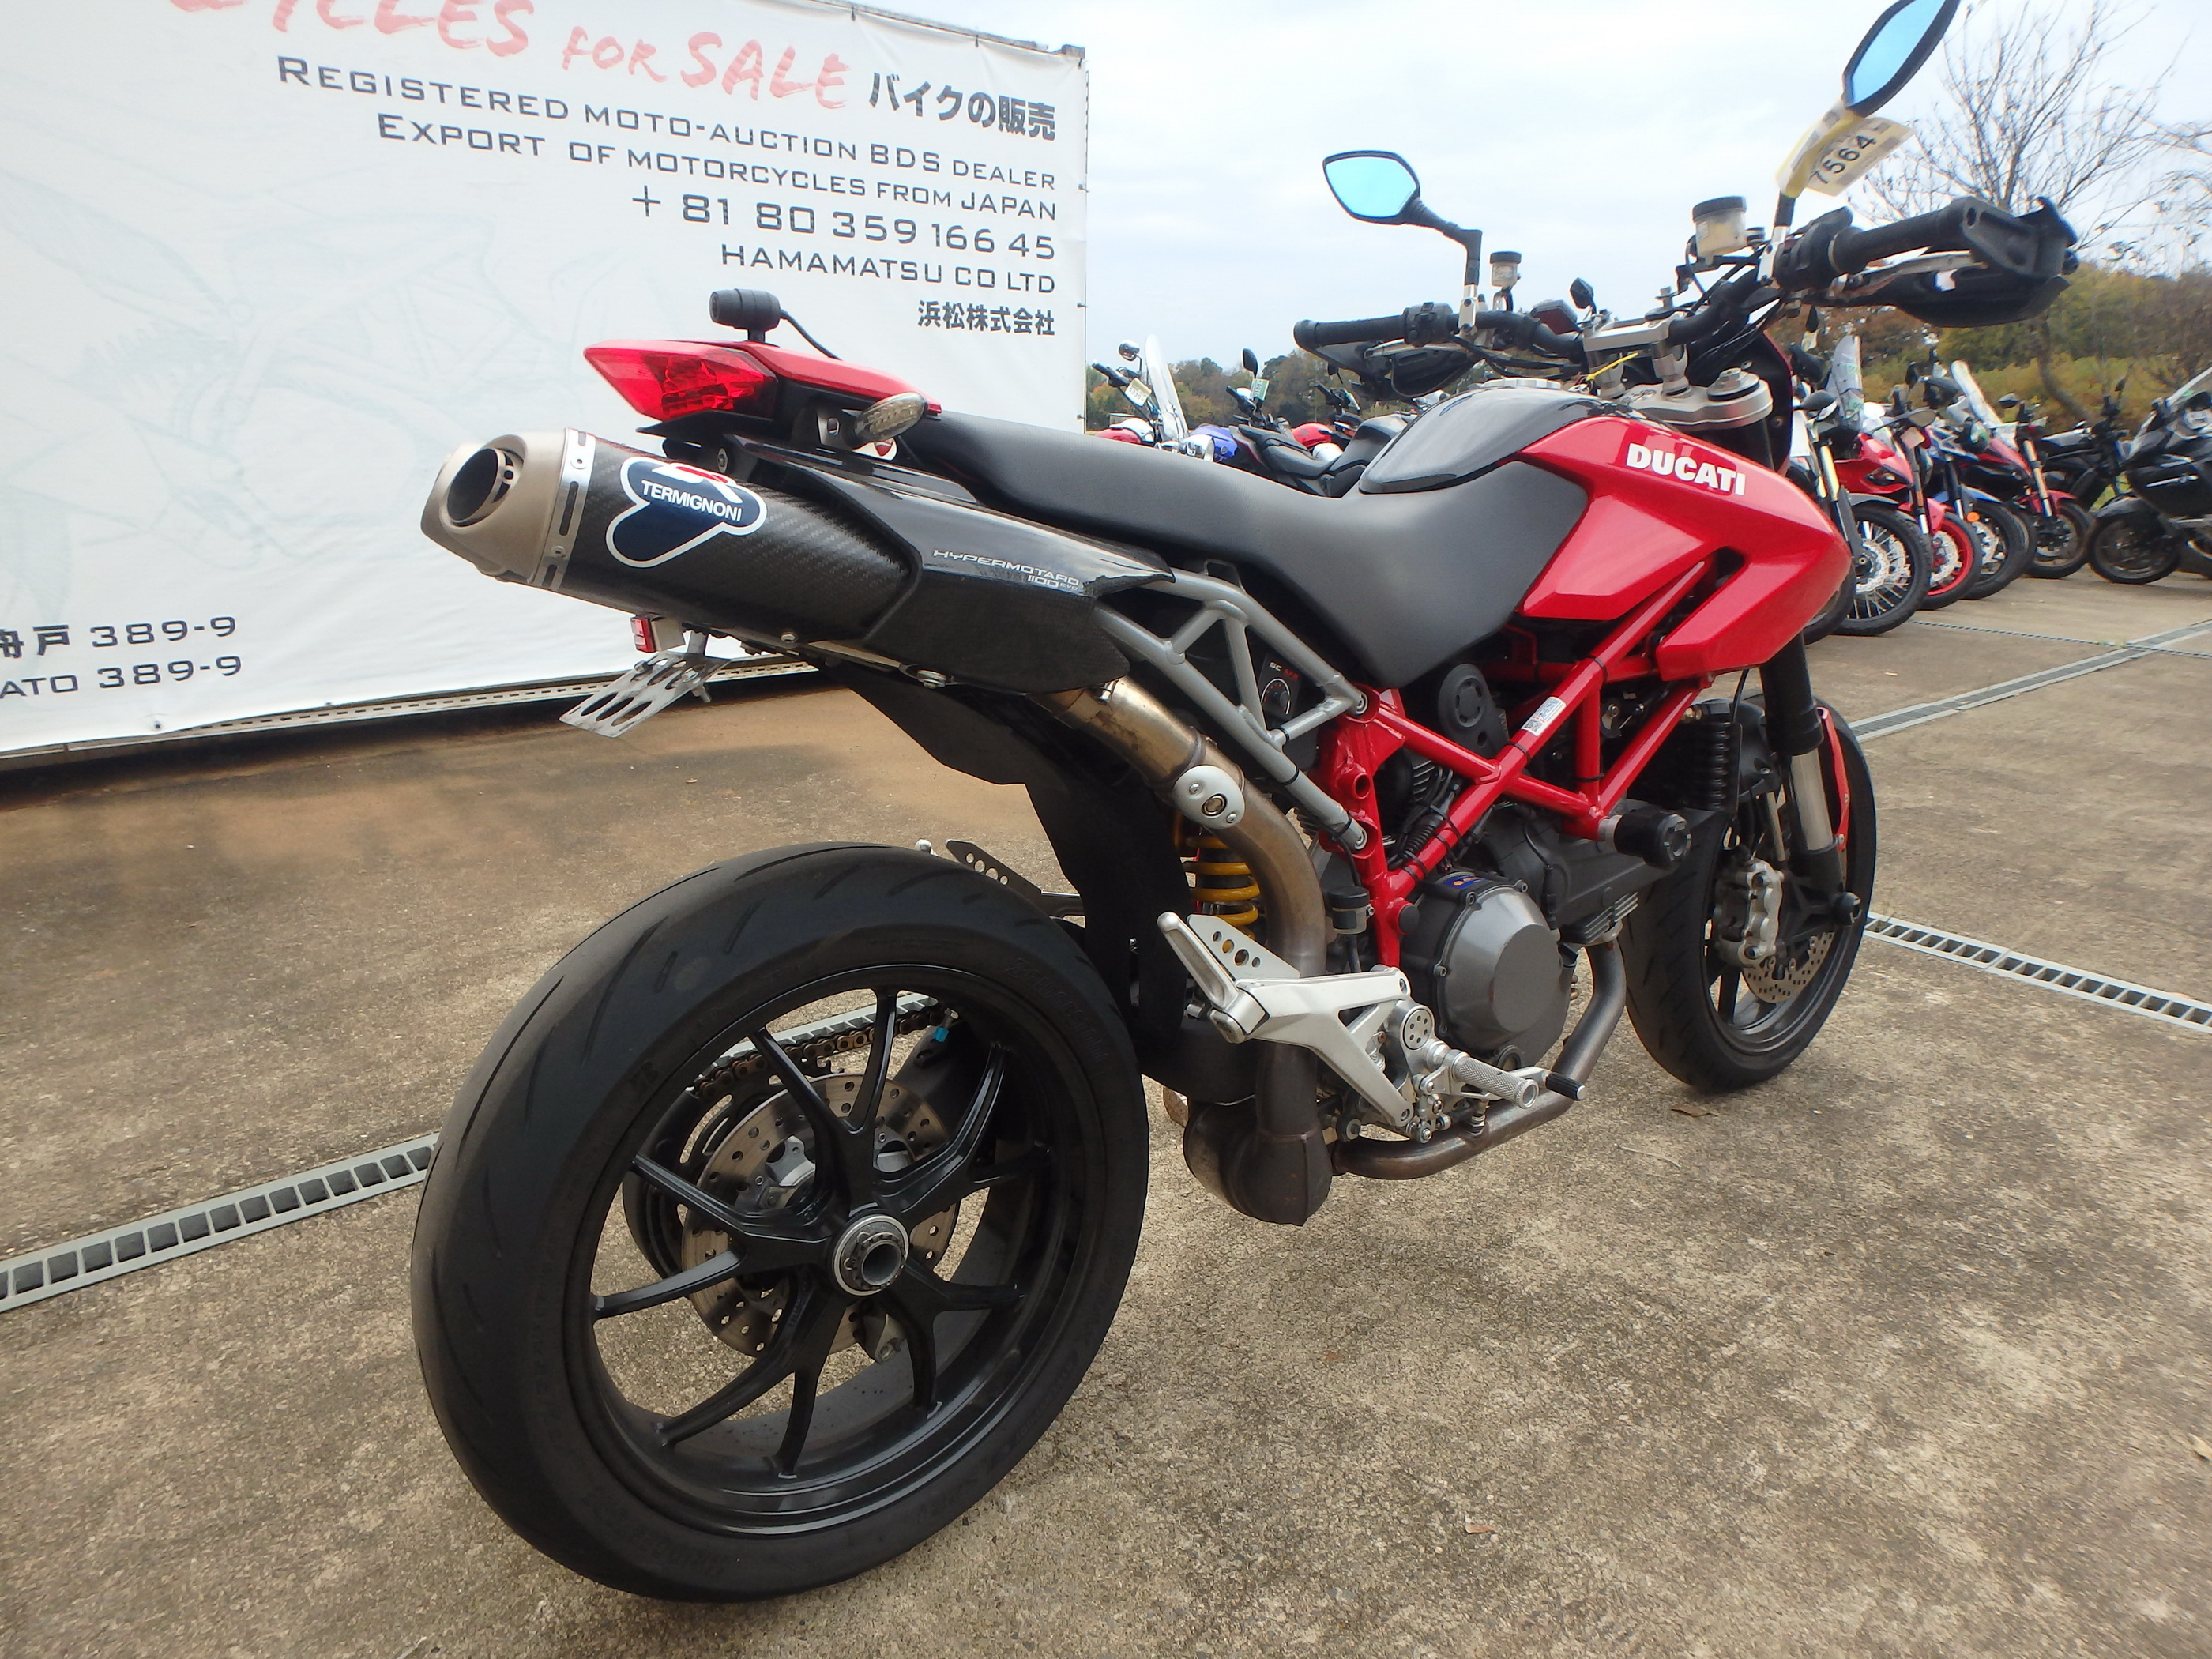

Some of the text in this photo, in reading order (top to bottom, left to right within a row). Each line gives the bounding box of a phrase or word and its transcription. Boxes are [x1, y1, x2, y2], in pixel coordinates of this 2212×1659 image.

[562, 26, 666, 82] FOR
[680, 32, 852, 109] SALE
[277, 56, 1055, 190] REGISTERED MOTO-AUCTION BDS DEALER
[870, 73, 1055, 141] バイクの販売
[378, 113, 1055, 220] EXPORT OF MOTORCYCLES FROM JAPAN
[683, 194, 729, 225] 81
[756, 203, 814, 234] 80
[833, 211, 916, 243] 359
[931, 223, 995, 253] 166
[1008, 235, 1055, 260] 45
[721, 244, 1055, 294] HAMAMATSU CO LTD
[917, 300, 1055, 336] 浜松株式会社
[1626, 443, 1746, 495] DUCATI
[641, 480, 742, 522] TERMIGNONI
[933, 550, 1080, 585] HYPERMOTARD
[90, 616, 236, 648] 389-9
[96, 656, 242, 689] 389-9
